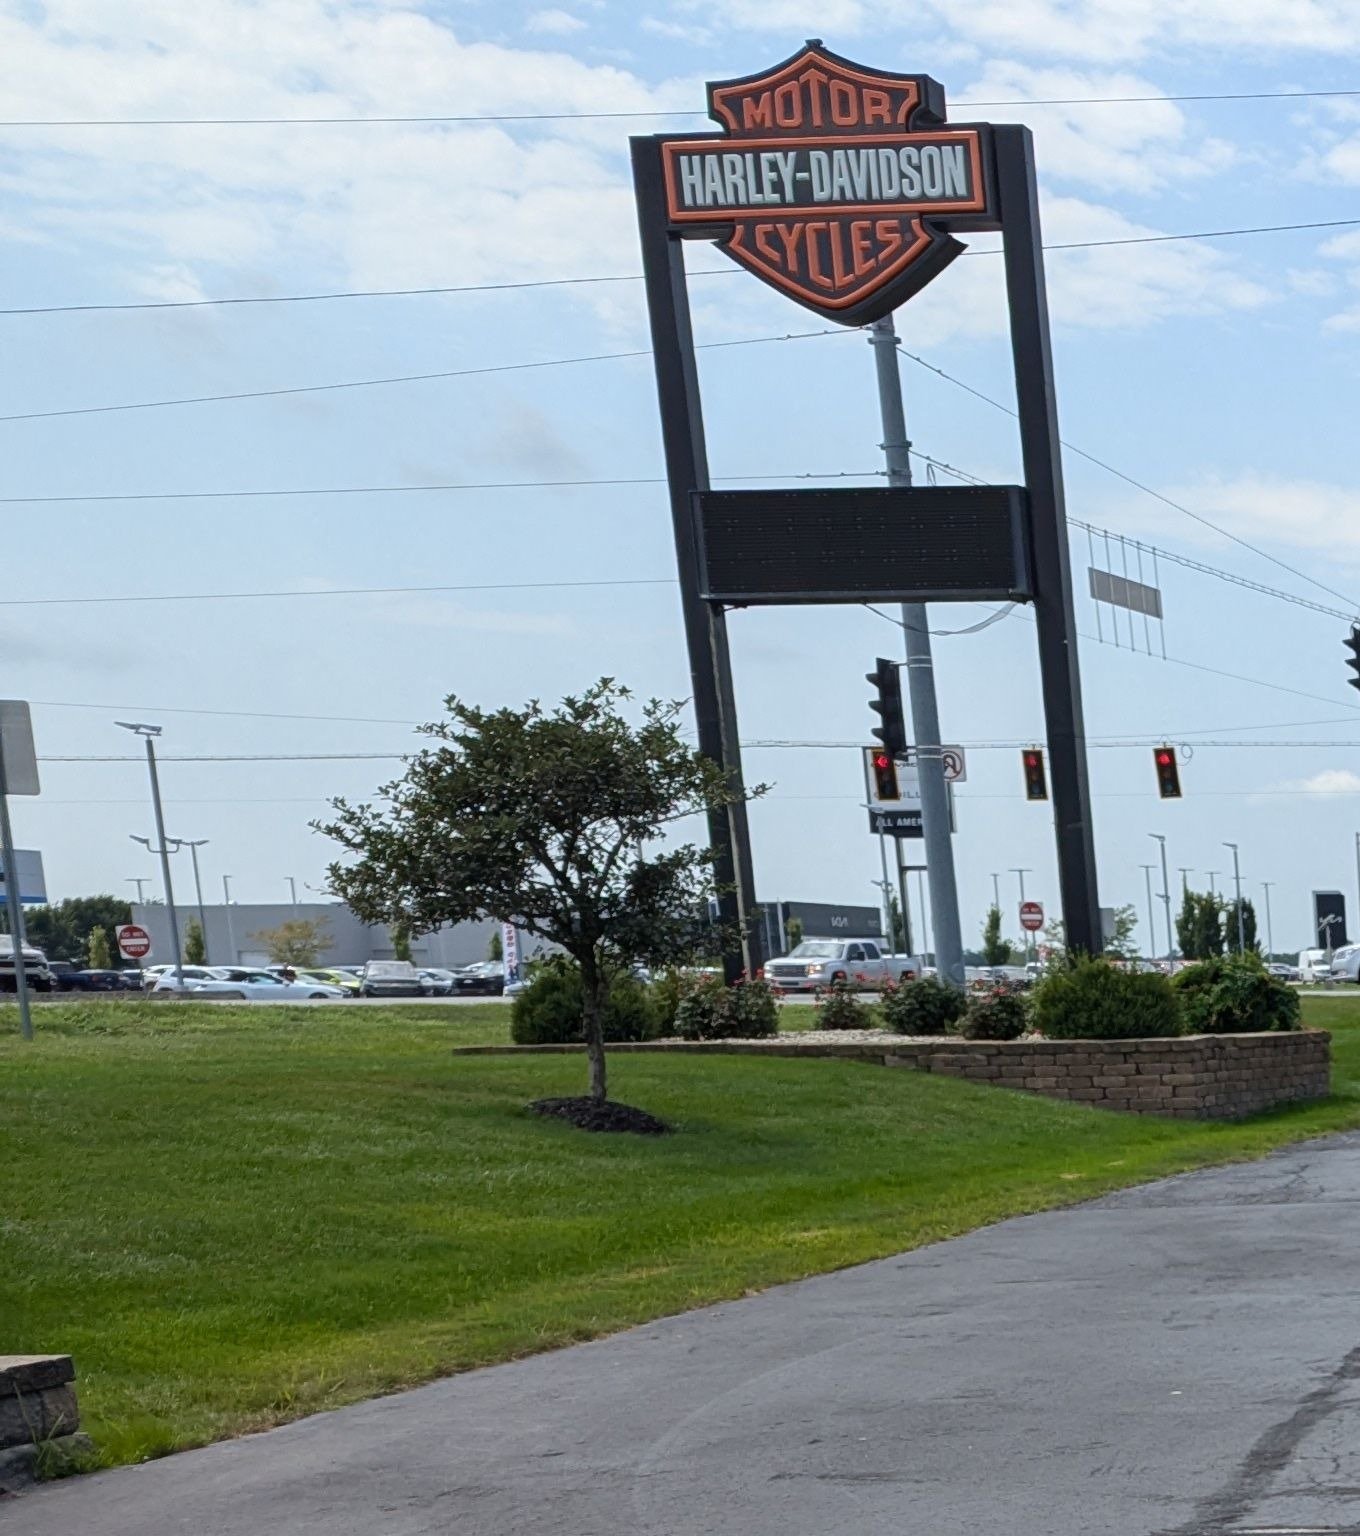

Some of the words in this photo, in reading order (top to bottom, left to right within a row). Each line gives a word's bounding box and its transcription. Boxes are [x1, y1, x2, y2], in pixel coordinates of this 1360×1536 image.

[742, 68, 894, 130] MOTOR
[679, 145, 968, 206] HARLEY-DAVIDSON
[754, 219, 900, 291] CYCLES
